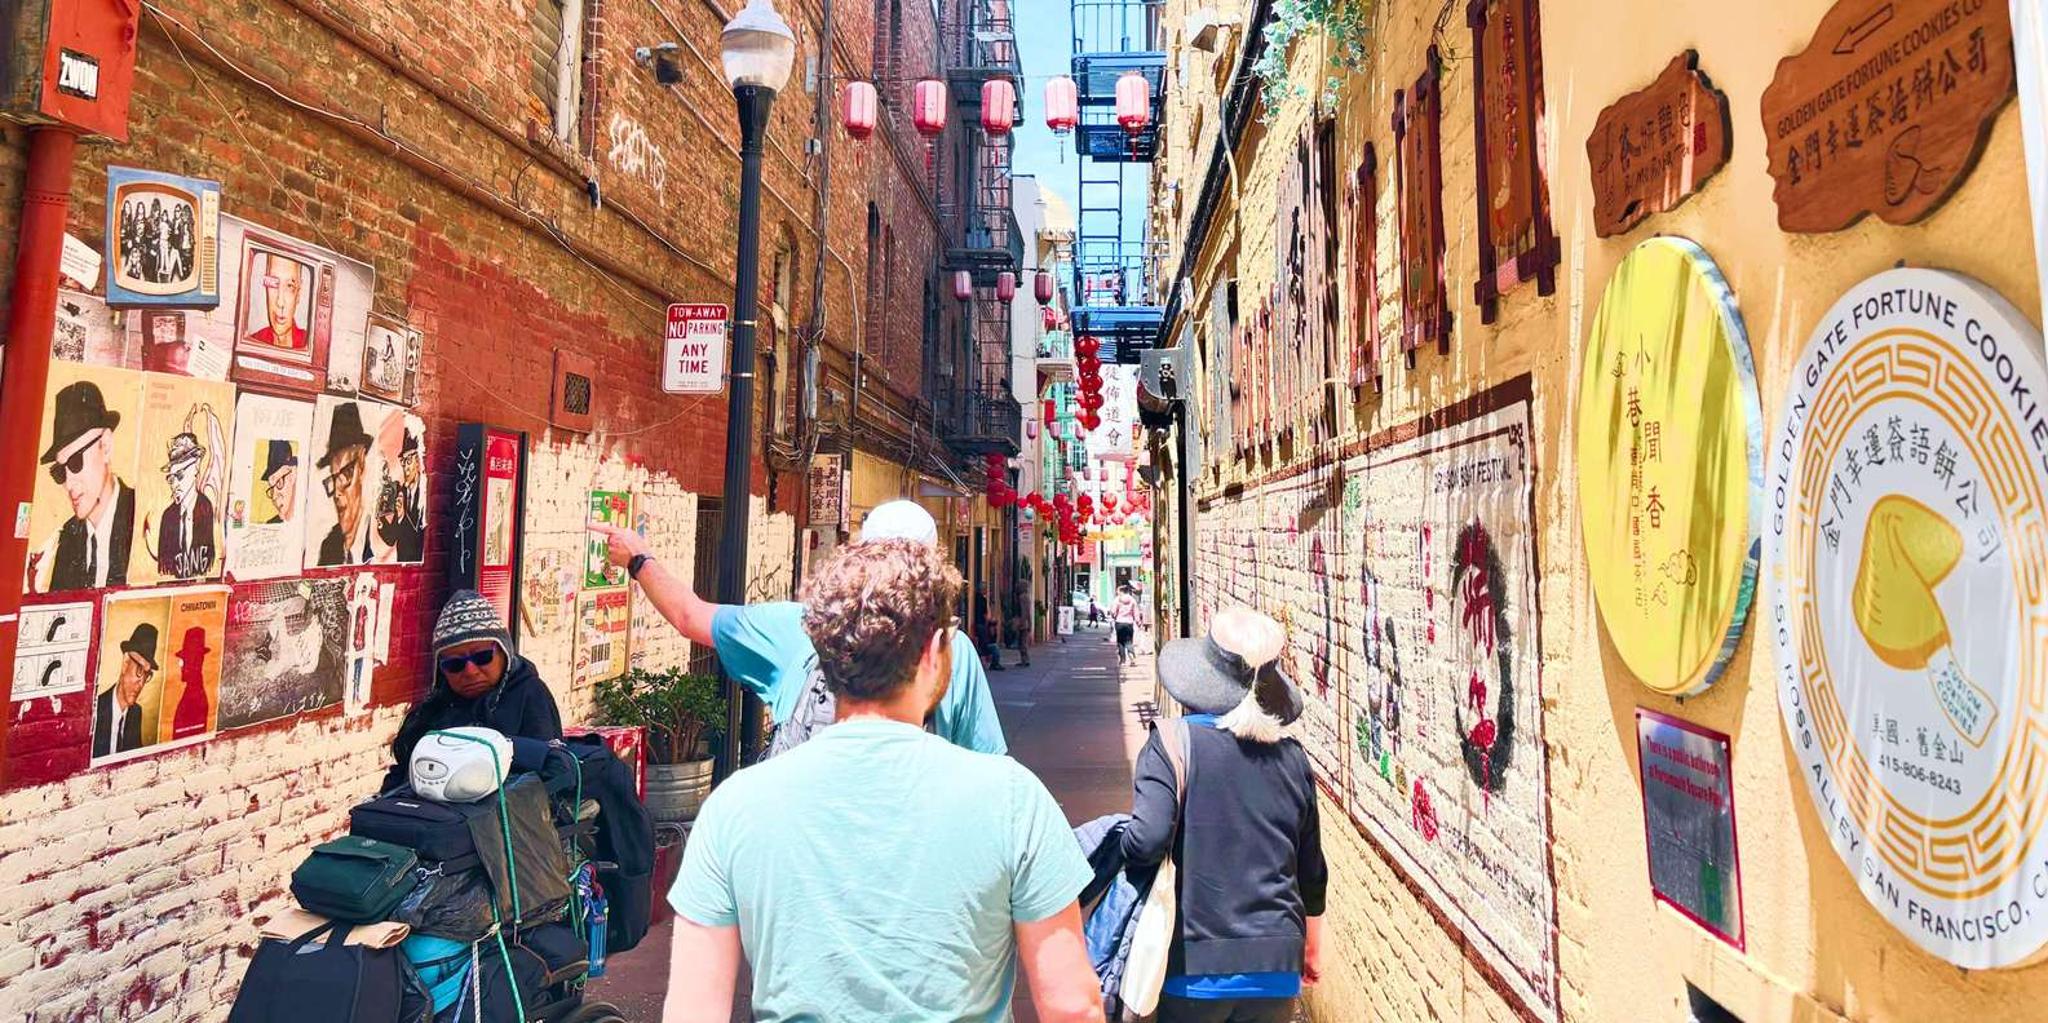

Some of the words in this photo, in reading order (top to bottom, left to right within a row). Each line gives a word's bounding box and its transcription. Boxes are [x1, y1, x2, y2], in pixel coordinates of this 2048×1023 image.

[1777, 98, 1817, 139] GOLDEN
[1818, 79, 1847, 113] GATE
[1847, 43, 1901, 95] FORTUNE
[1903, 9, 1961, 57] COOKIES
[673, 307, 722, 318] TOW-AWAY
[669, 321, 687, 338] NO
[688, 323, 723, 335] PARKING
[679, 360, 708, 374] TIME
[681, 344, 708, 357] ANY
[1774, 394, 1807, 536] GOLDEN
[1806, 320, 1849, 389] GATE
[1852, 288, 1958, 330] FORTUNE
[175, 545, 208, 578] JANG
[181, 601, 216, 612] CHINATOWN
[1948, 660, 1981, 712] CUSTOM
[1878, 754, 1962, 796] 415-806-8243
[1784, 663, 1812, 750] ROSS
[1812, 763, 1859, 852] ALLEY
[1863, 856, 1899, 907] SAN
[1907, 899, 2031, 942] FRANCISCO,
